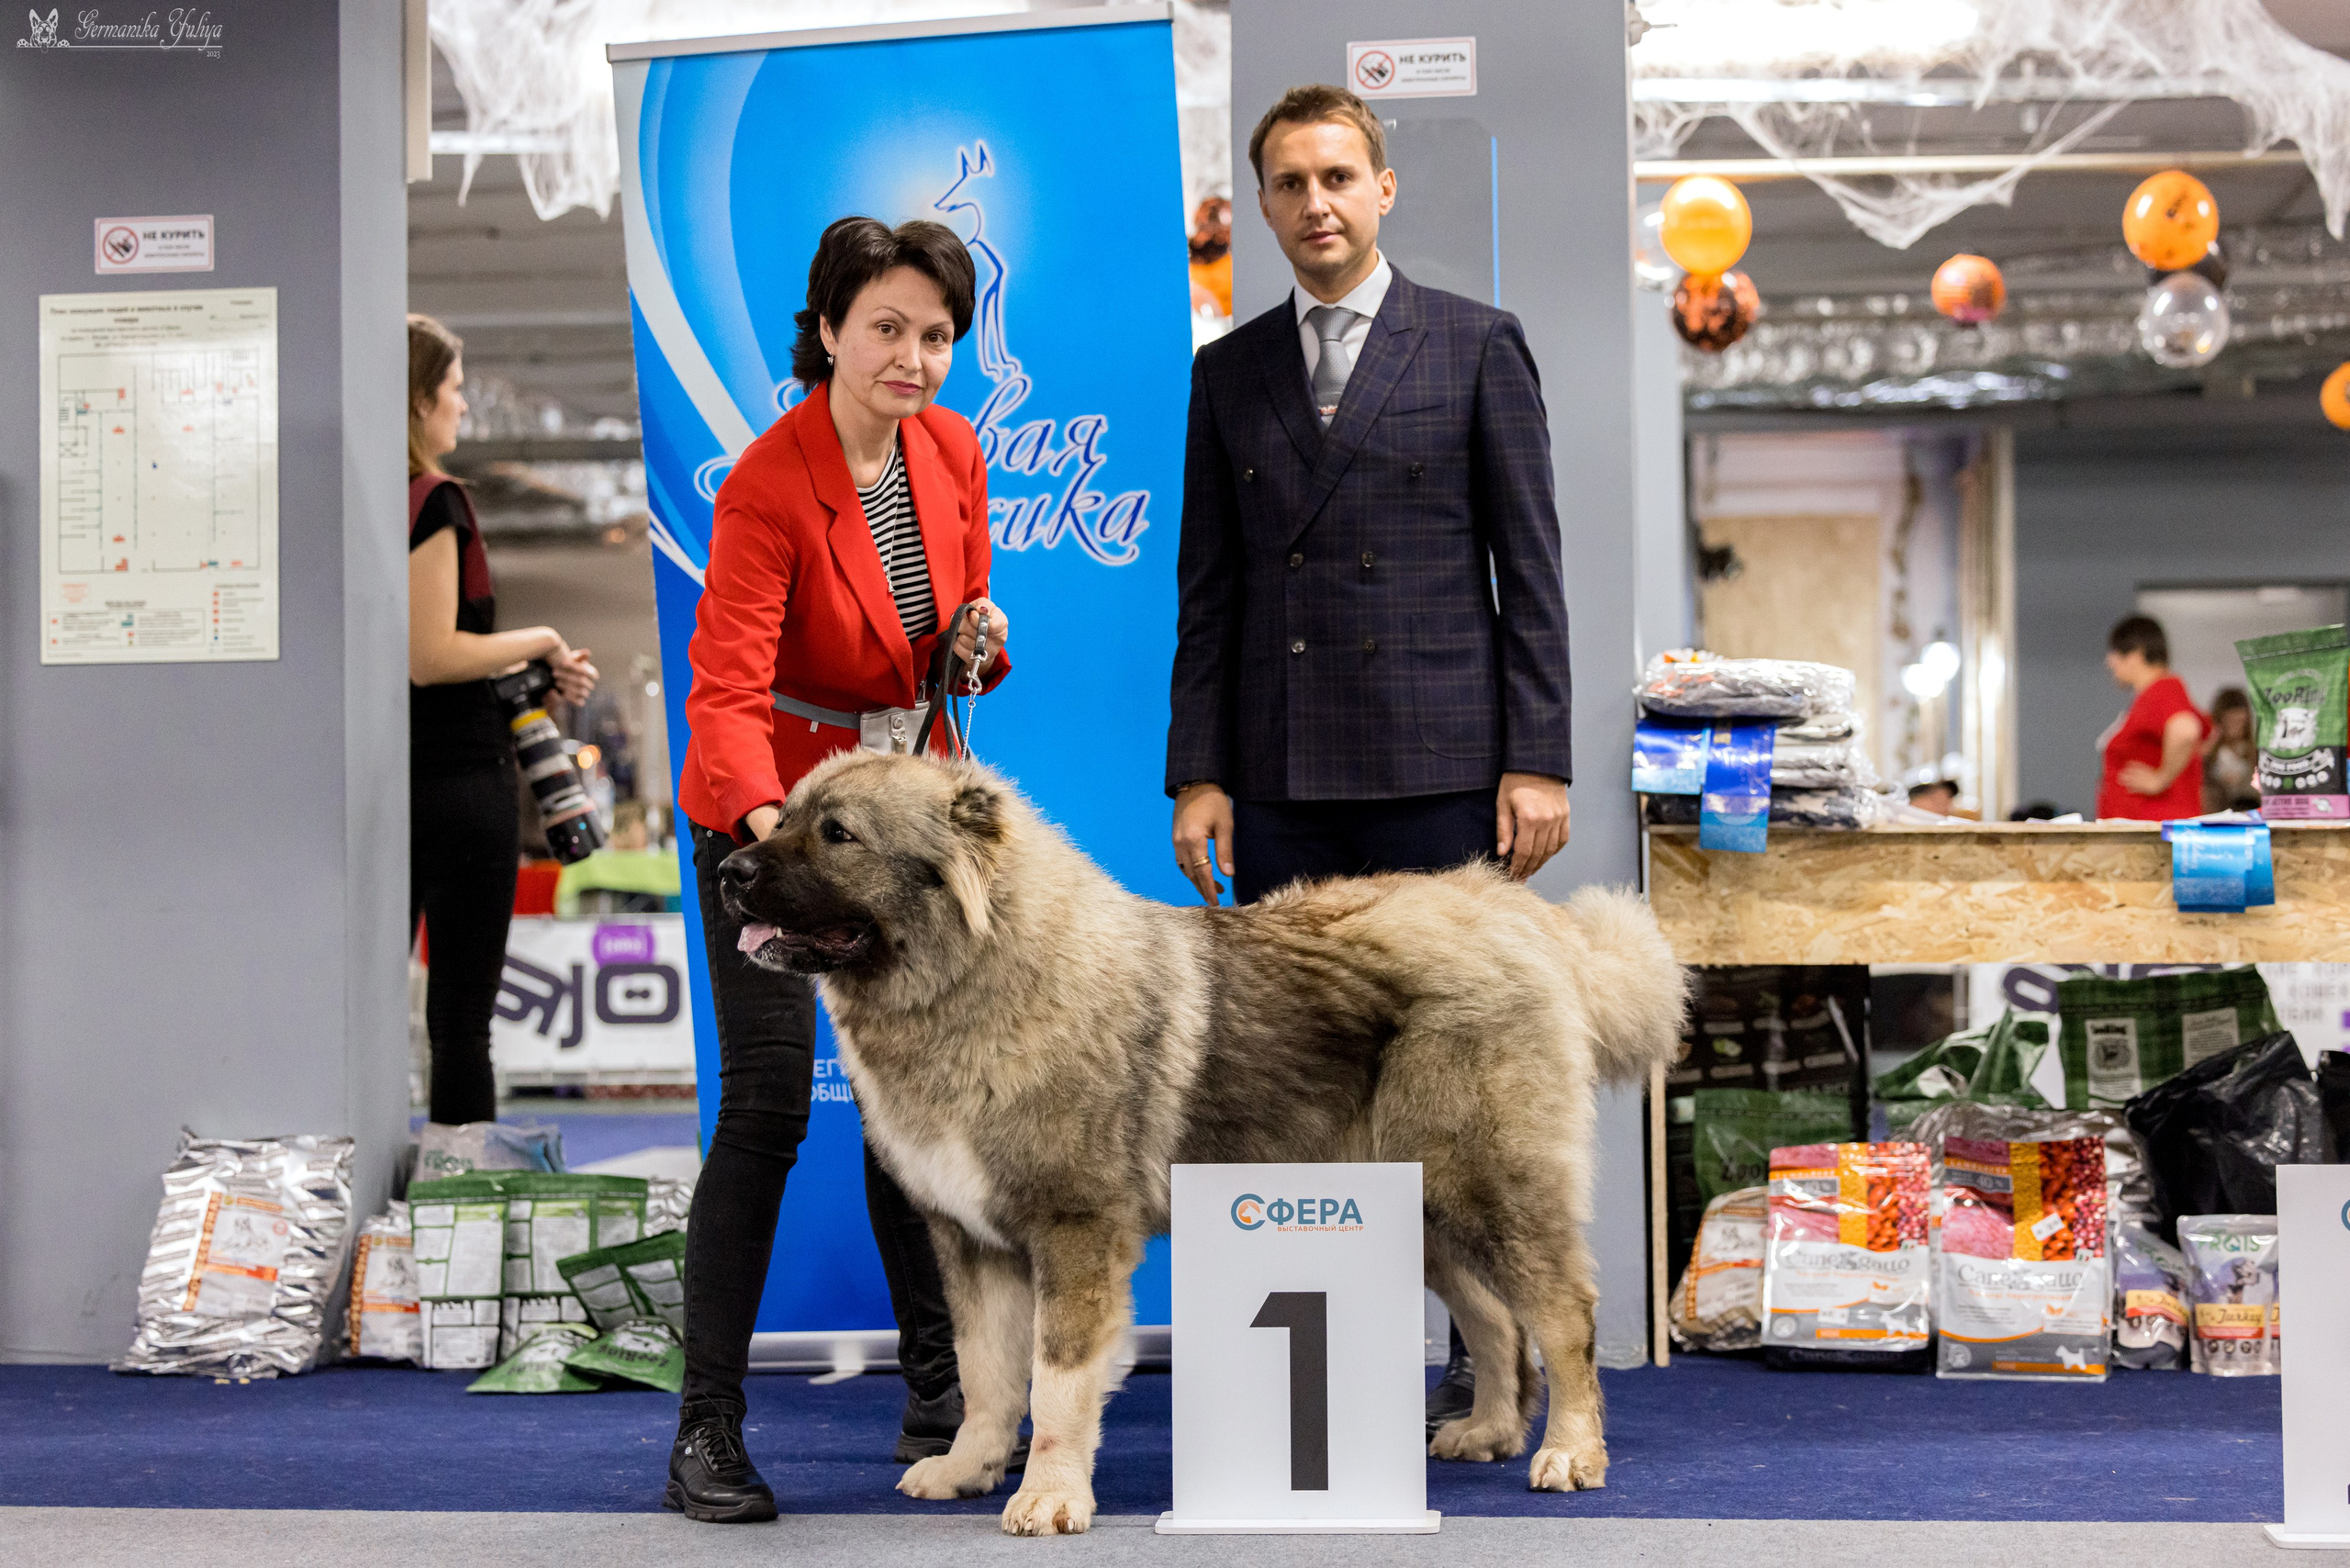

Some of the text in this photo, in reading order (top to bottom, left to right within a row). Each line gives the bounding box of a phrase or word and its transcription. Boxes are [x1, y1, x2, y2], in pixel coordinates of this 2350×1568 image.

[1398, 53, 1467, 64] НЕ КУРИТЬ
[1230, 1193, 1364, 1231] СФЕРА
[1249, 1291, 1329, 1491] 1
